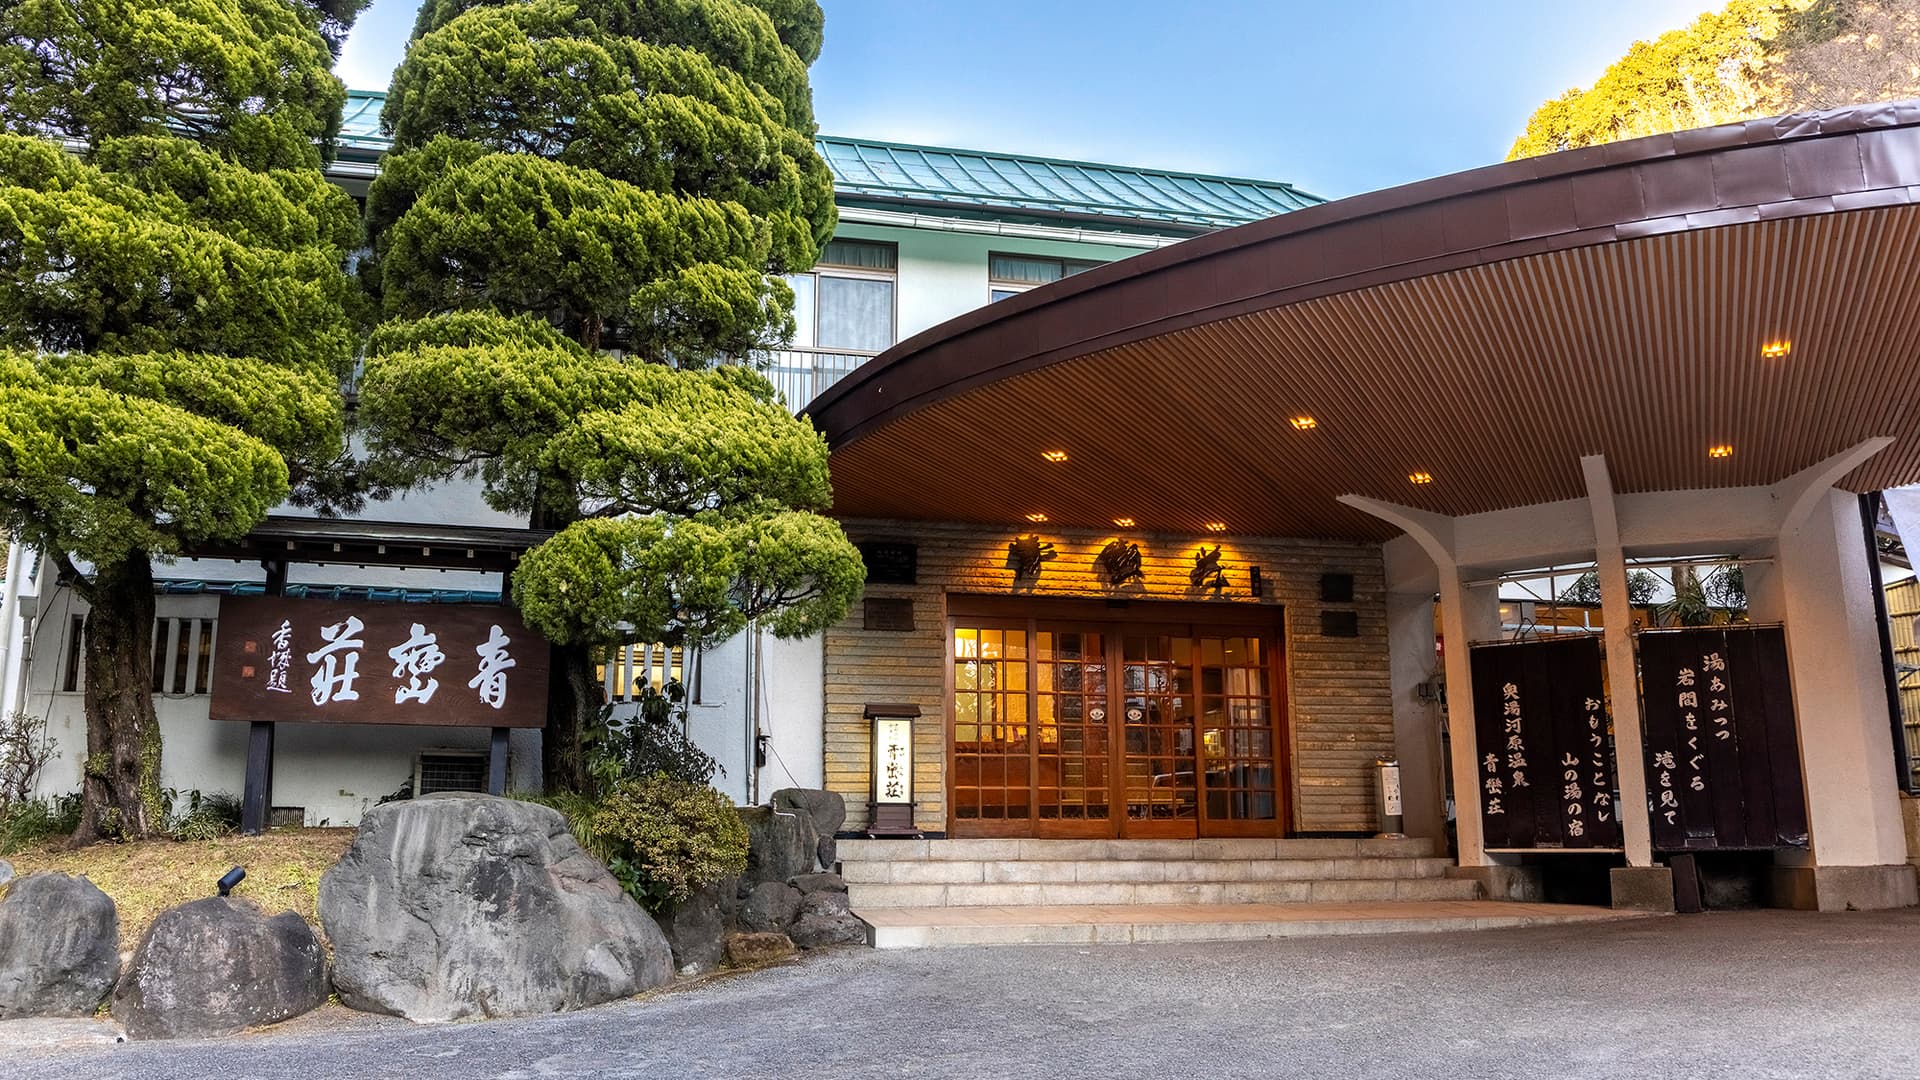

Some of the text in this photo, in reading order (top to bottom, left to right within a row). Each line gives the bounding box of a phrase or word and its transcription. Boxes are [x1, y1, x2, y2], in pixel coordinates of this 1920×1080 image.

[1502, 681, 1530, 788] 奥湯河原温泉
[1675, 667, 1705, 792] 岩間をくぐる
[1702, 652, 1731, 741] 湯あみつつ
[1561, 751, 1585, 837] 山の湯の宿
[1584, 697, 1611, 823] おもうことなし
[1652, 749, 1680, 825] 滝を見て
